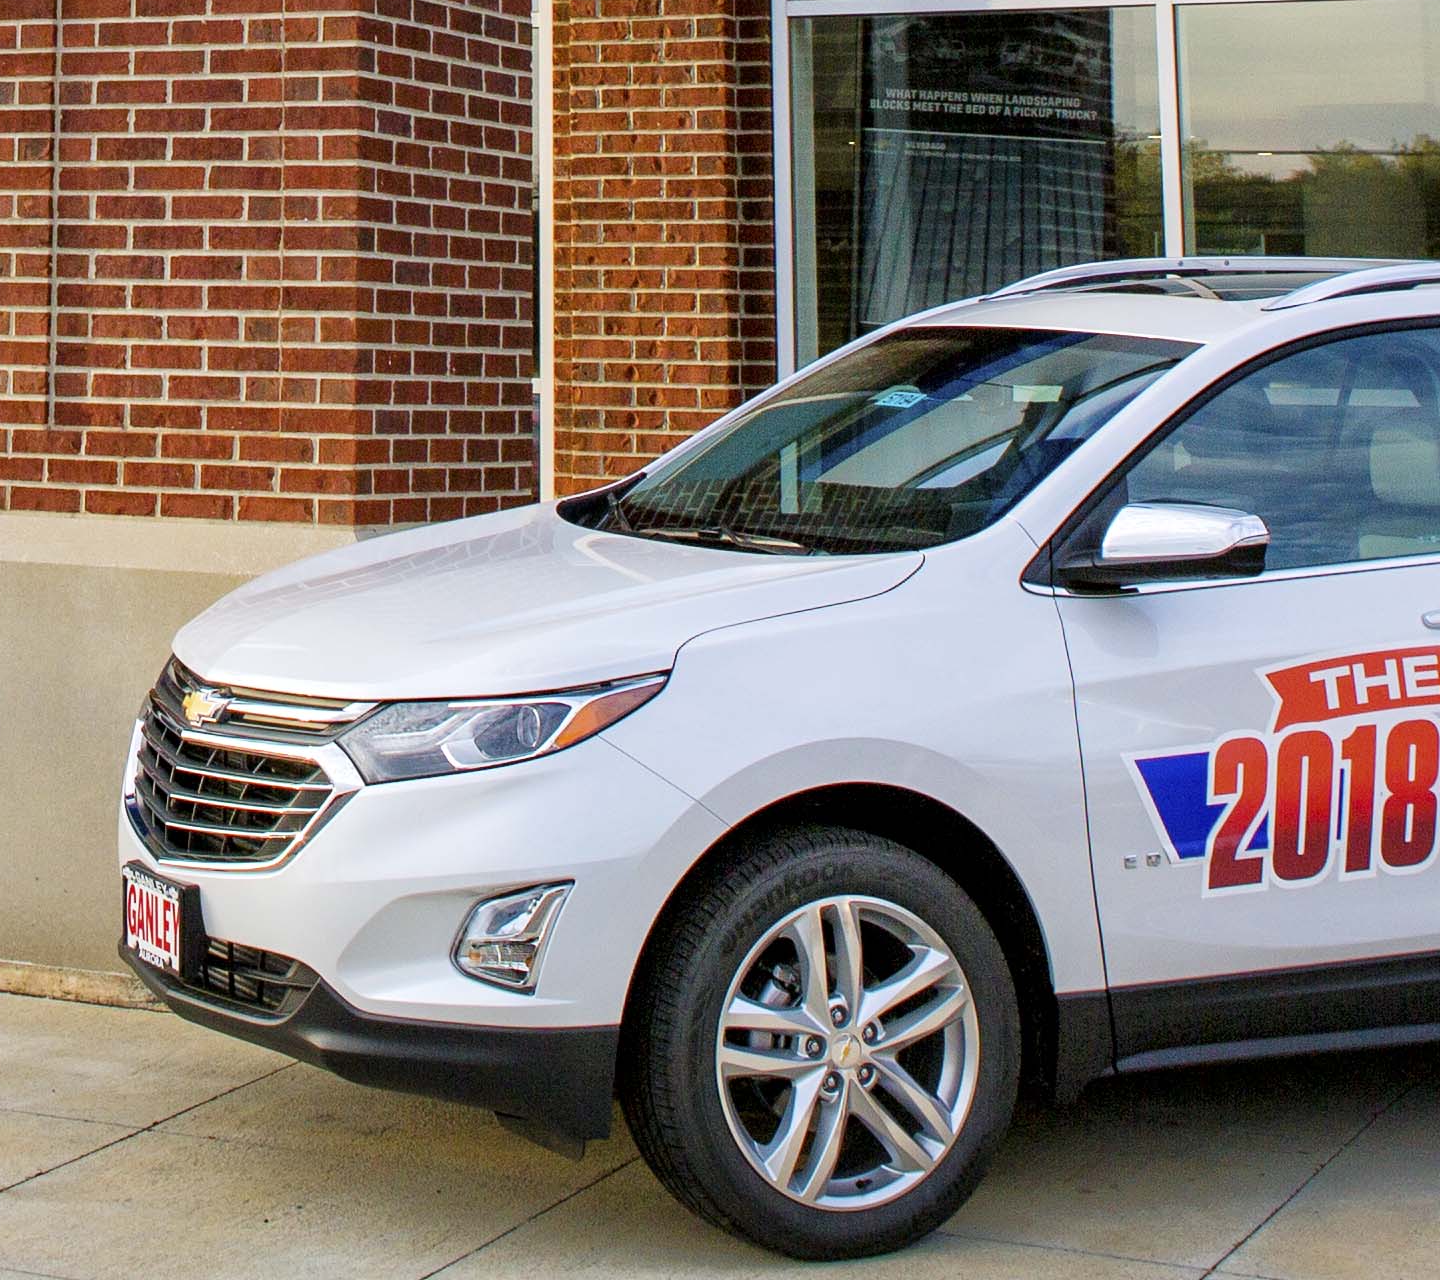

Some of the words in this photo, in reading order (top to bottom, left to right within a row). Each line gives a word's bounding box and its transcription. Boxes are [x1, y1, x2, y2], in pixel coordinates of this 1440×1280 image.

[869, 98, 911, 111] BLOCKS
[913, 101, 941, 112] MEET
[943, 103, 963, 114] THE
[965, 103, 985, 115] BED
[988, 104, 1001, 116] OF
[1003, 105, 1012, 116] A
[1013, 106, 1051, 119] PICKUP
[1055, 109, 1098, 121] TRUCK?
[886, 88, 917, 100] WHAT
[919, 89, 968, 103] HAPPENS
[970, 92, 1003, 104] WHEN
[1005, 94, 1081, 108] LANDSCAPING
[1207, 718, 1440, 890] 2018
[131, 871, 167, 894] GANLEY
[127, 883, 180, 957] GANLEY
